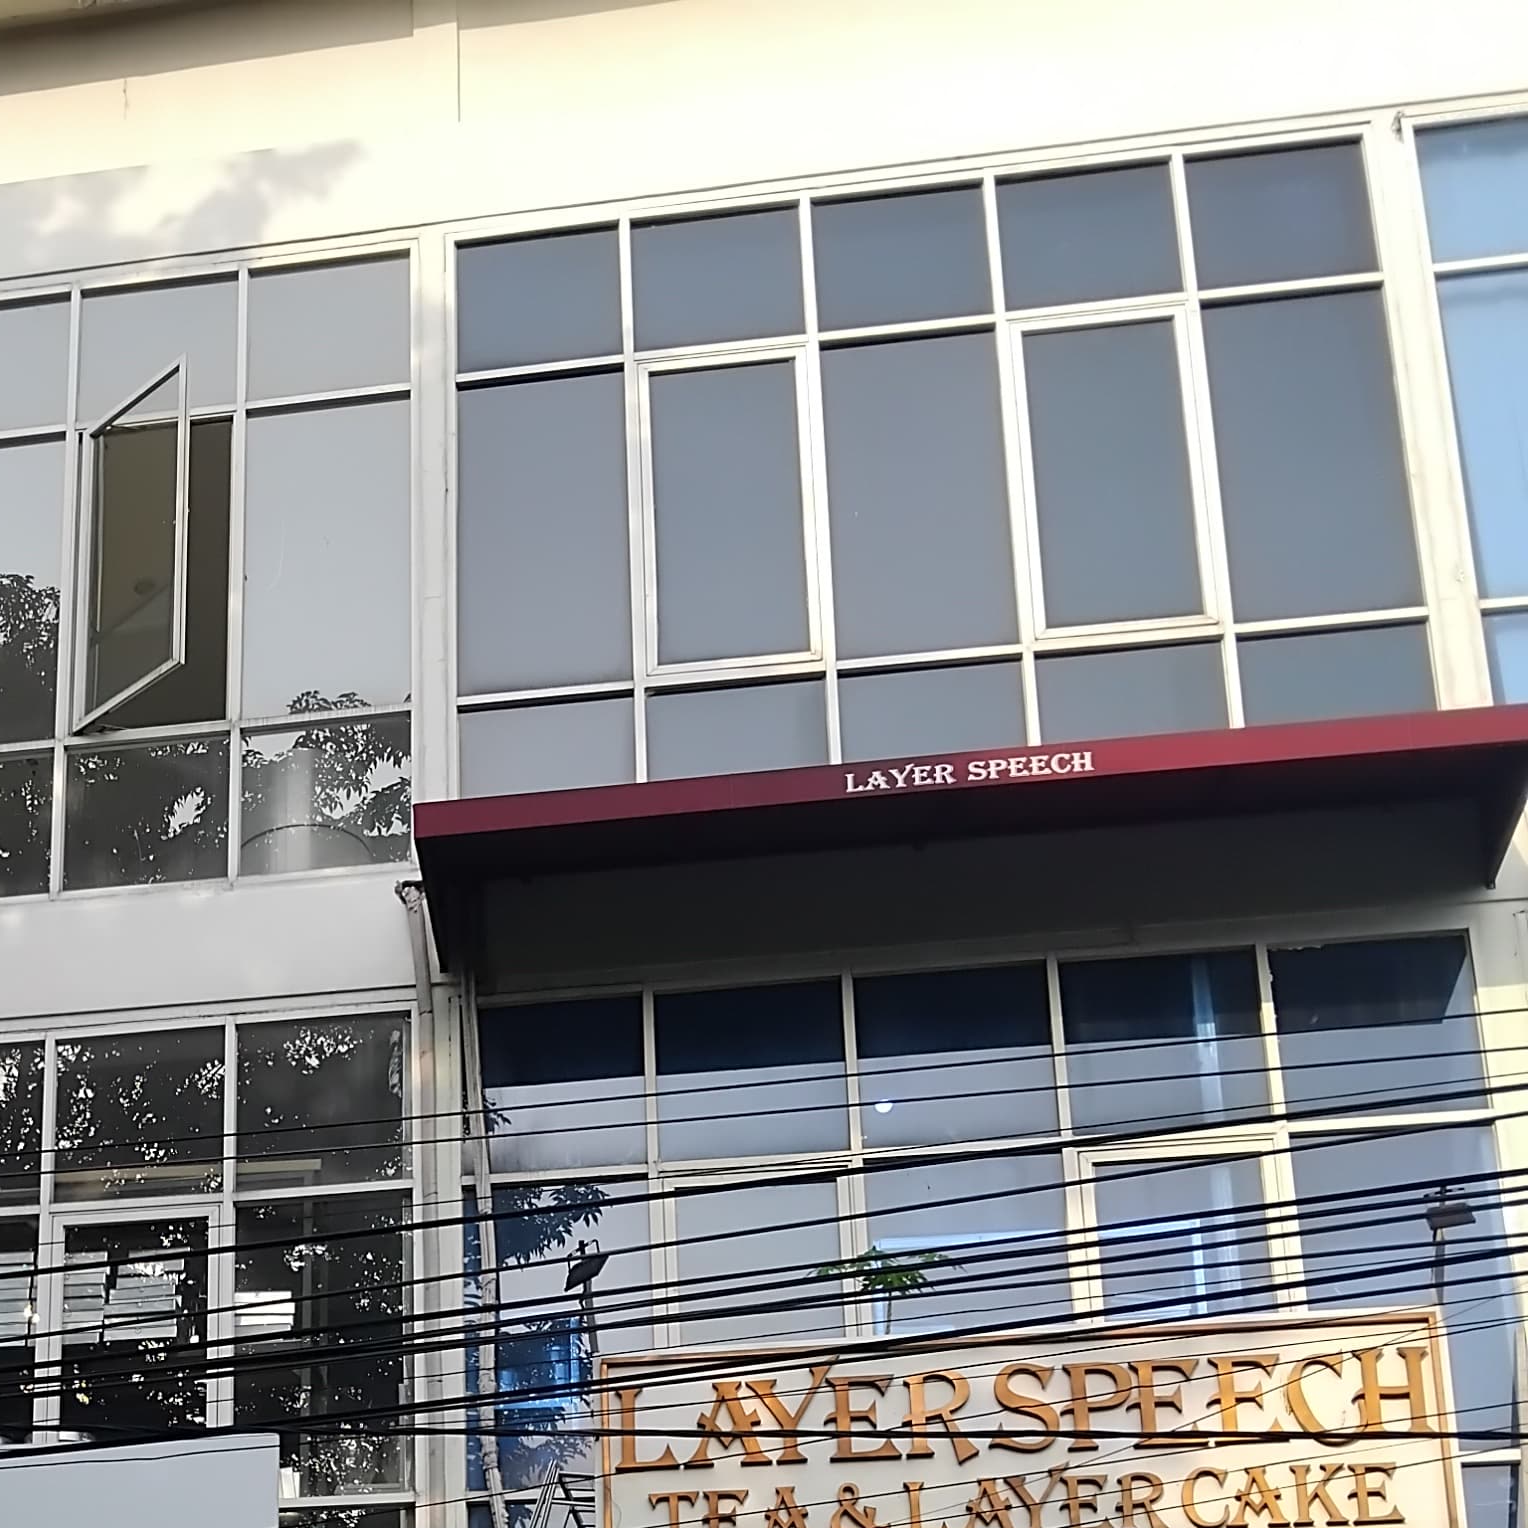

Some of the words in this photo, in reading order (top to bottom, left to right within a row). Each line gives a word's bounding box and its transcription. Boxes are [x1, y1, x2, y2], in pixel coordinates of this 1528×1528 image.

[845, 763, 957, 793] LAYER
[967, 751, 1095, 781] SPEECH
[615, 1356, 980, 1473] LAYER
[989, 1345, 1438, 1454] SPEECH
